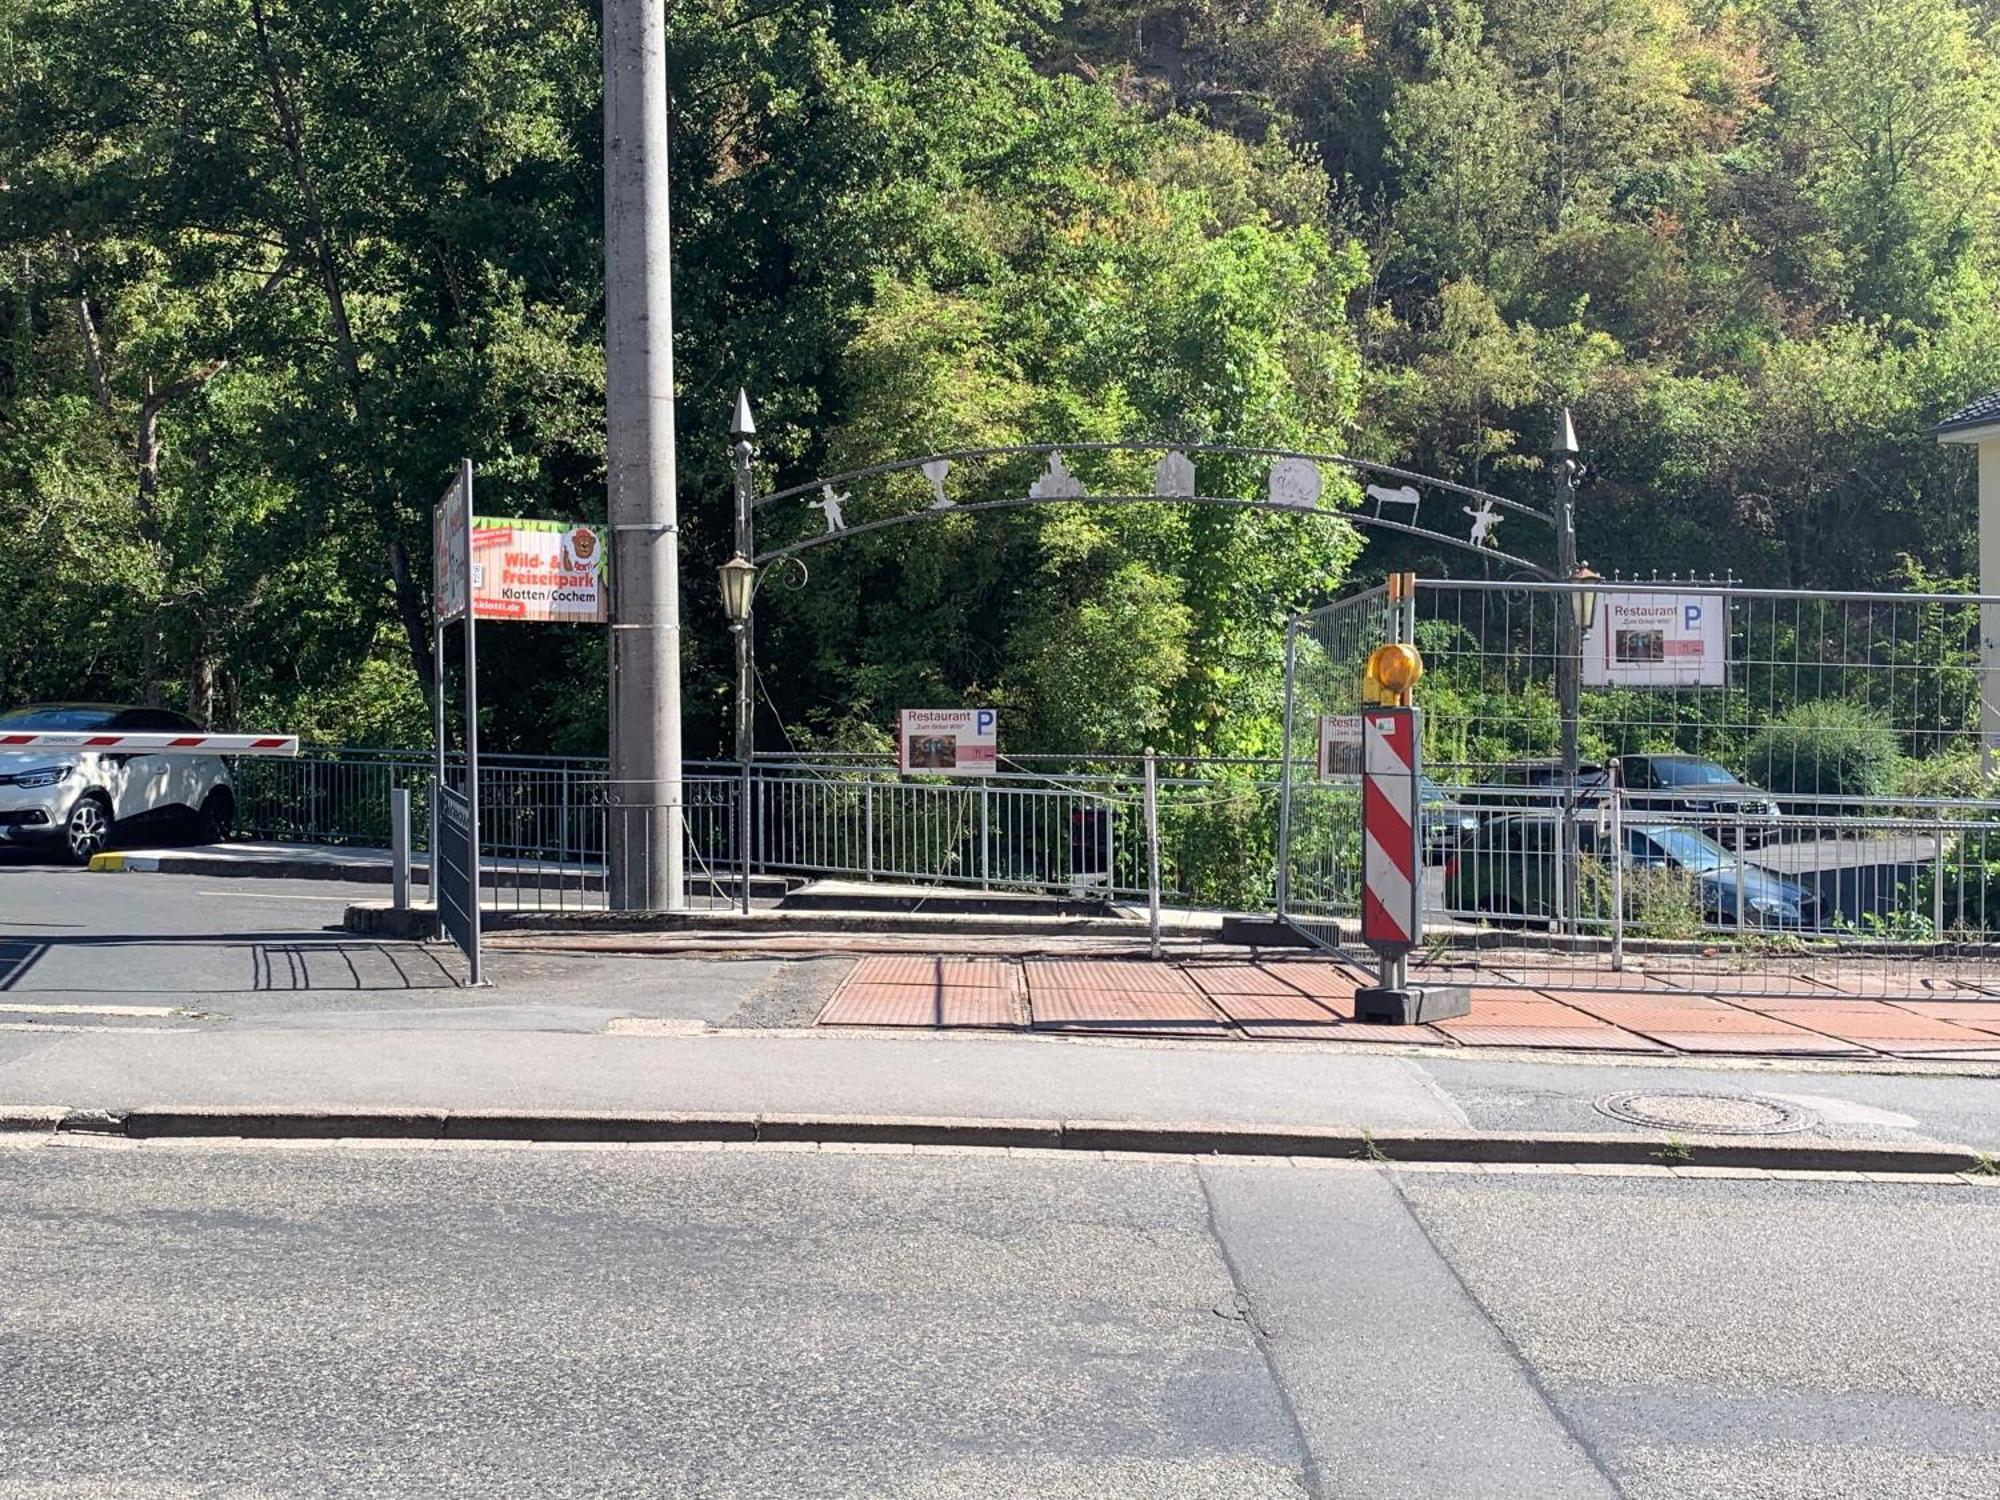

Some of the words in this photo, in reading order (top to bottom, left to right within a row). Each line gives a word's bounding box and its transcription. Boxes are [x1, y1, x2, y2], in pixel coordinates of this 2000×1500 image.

[505, 552, 544, 569] Wild-
[551, 555, 560, 569] &
[503, 569, 594, 589] Freizeitpark
[1615, 606, 1678, 617] Restaurant
[1684, 605, 1701, 631] P
[908, 711, 971, 721] Restaurant
[977, 711, 994, 736] P
[1329, 716, 1361, 728] Resta
